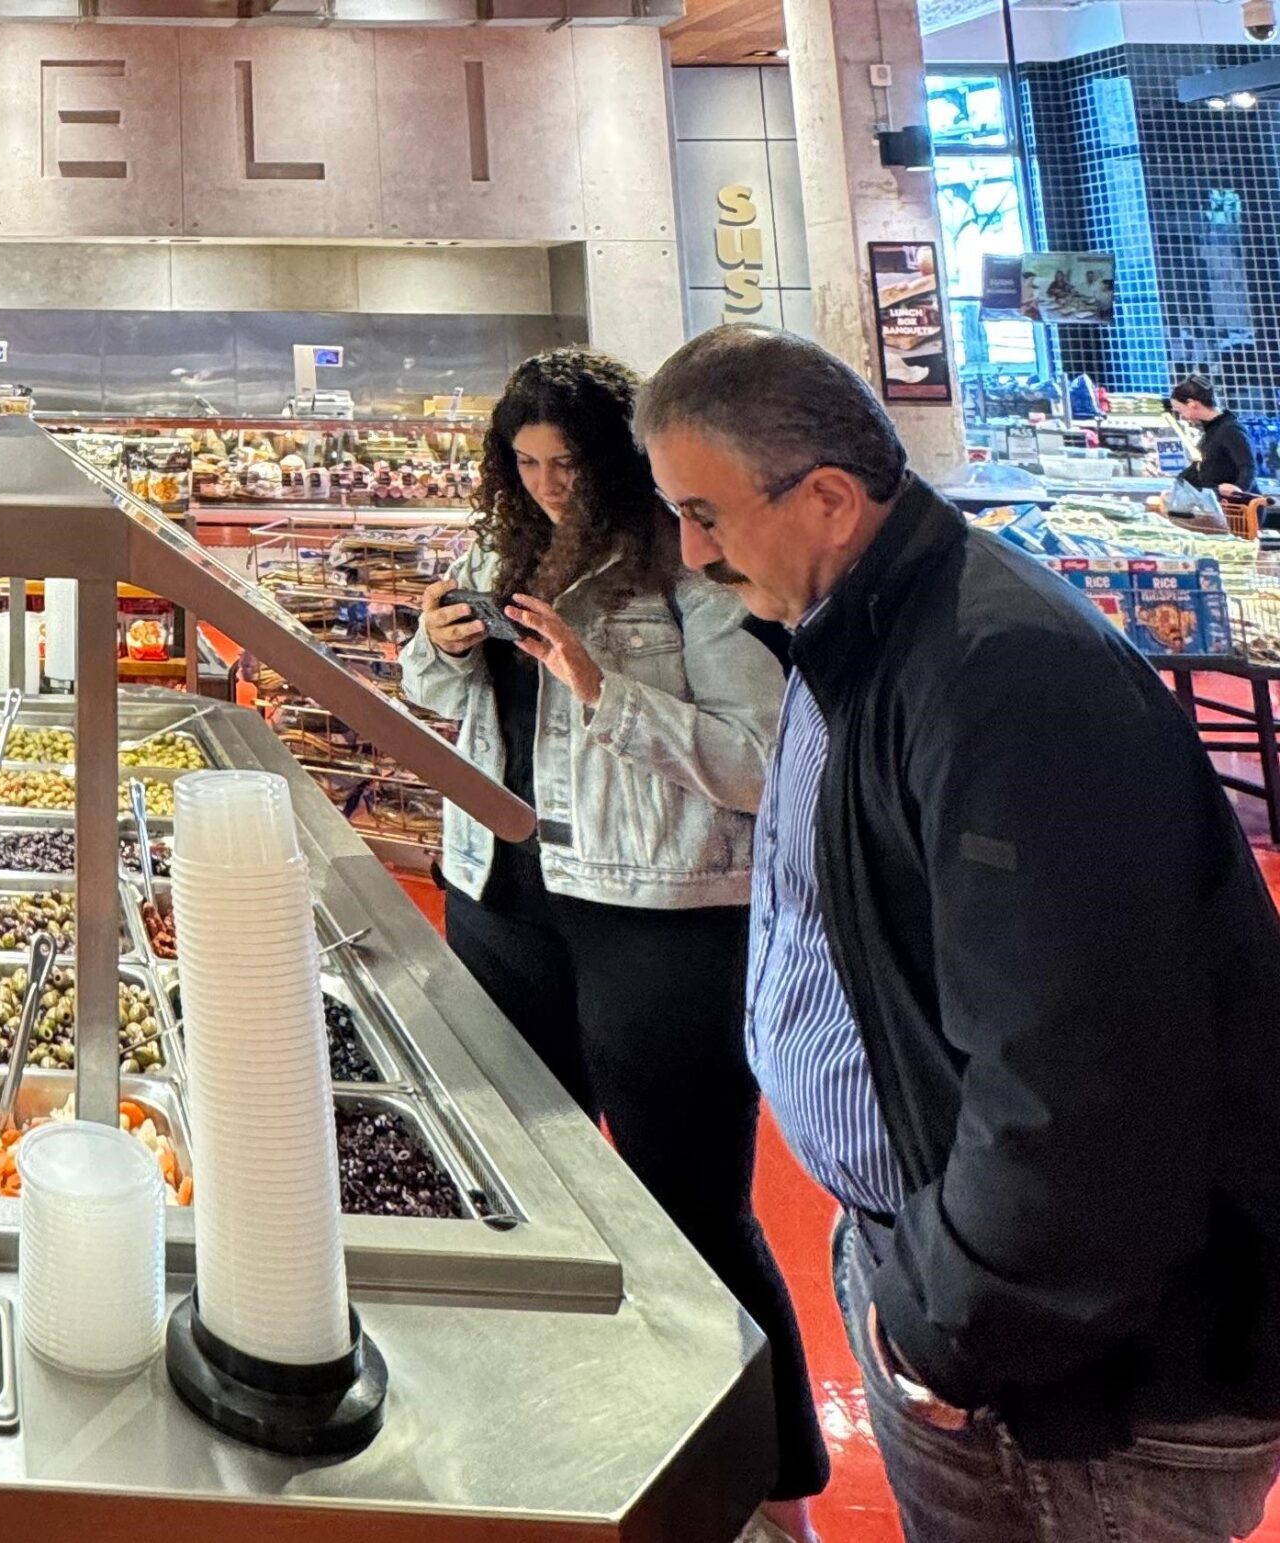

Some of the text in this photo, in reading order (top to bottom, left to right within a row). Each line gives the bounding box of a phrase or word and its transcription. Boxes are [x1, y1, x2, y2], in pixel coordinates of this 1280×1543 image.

[715, 184, 763, 325] sus
[889, 309, 923, 318] LUNCH
[897, 317, 917, 326] BOX
[1157, 441, 1184, 453] OPEN
